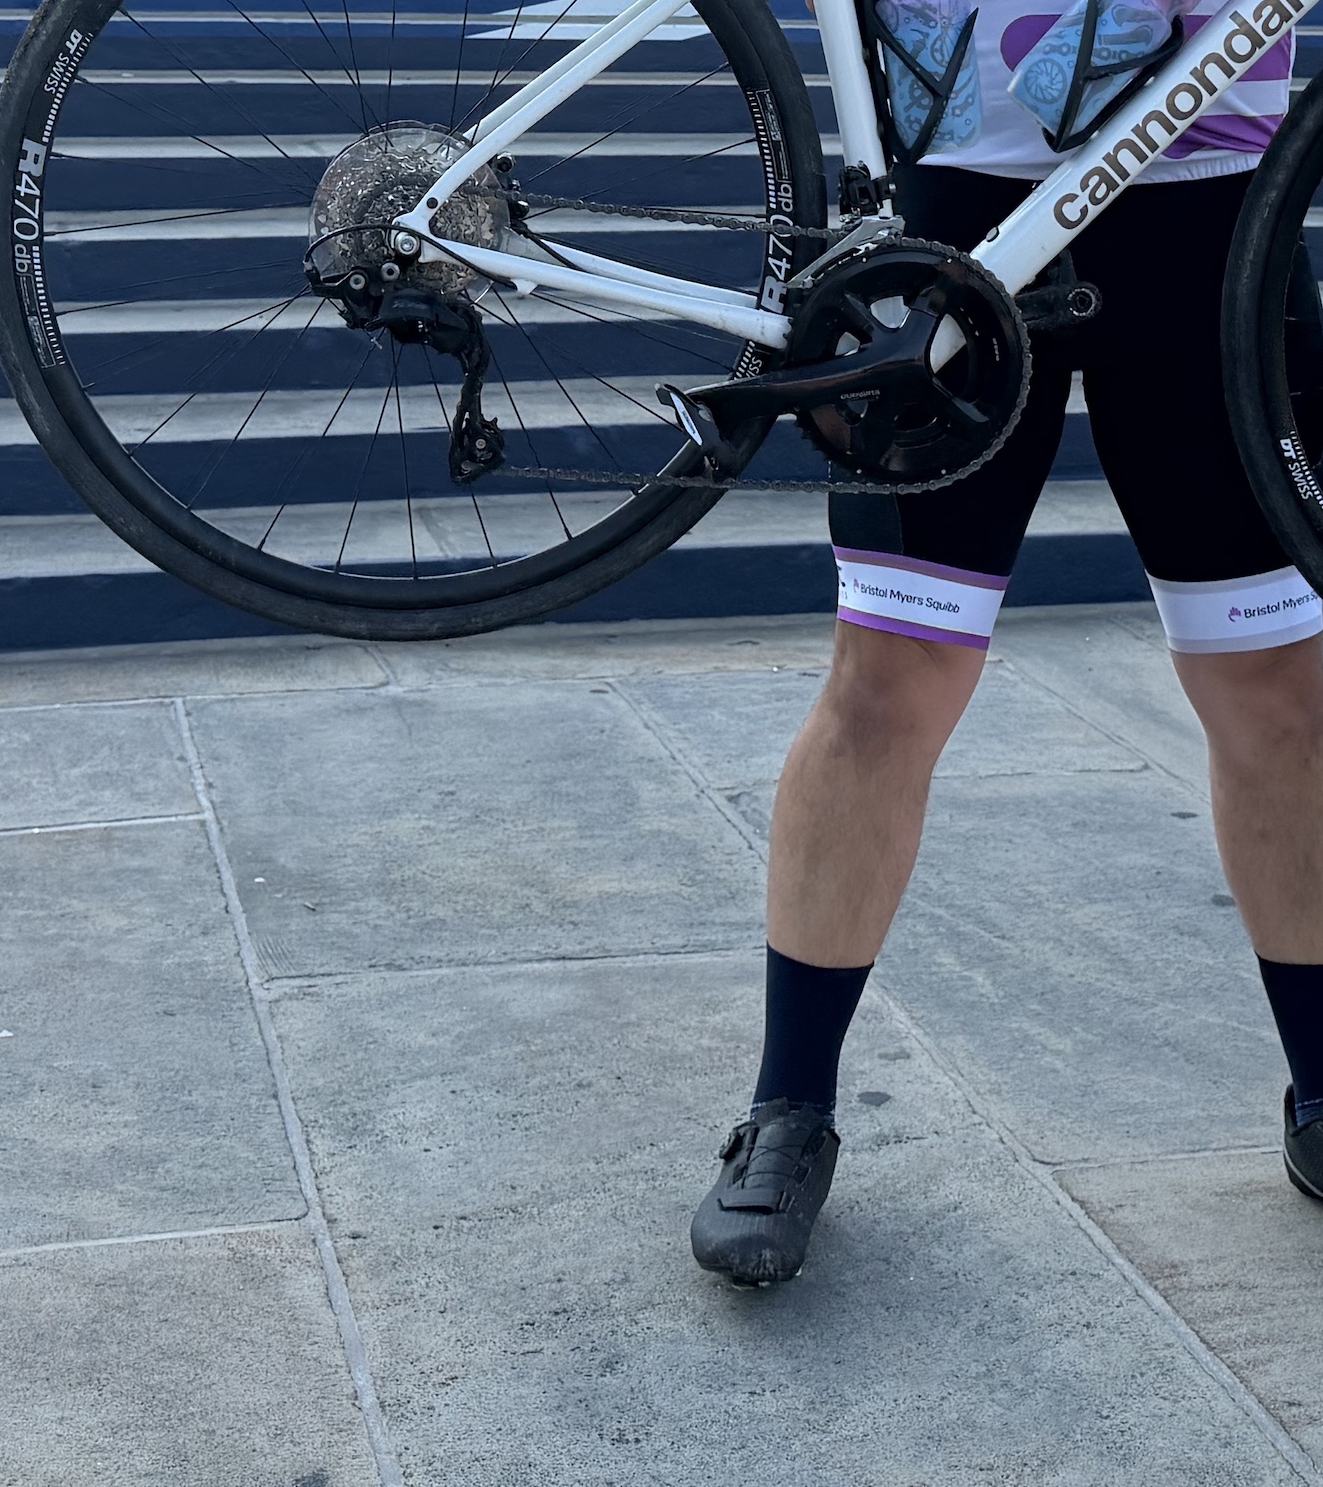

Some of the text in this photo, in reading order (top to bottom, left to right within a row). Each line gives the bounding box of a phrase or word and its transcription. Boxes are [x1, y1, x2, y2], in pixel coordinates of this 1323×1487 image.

[44, 28, 83, 94] DT SWISS
[777, 183, 794, 213] db
[14, 243, 32, 273] db
[1279, 438, 1314, 500] DT SWISS
[860, 582, 888, 598] Bristol
[889, 589, 924, 604] Myers
[925, 597, 960, 614] Squibb
[1243, 601, 1281, 619] Bristol
[1282, 593, 1310, 611] Myers
